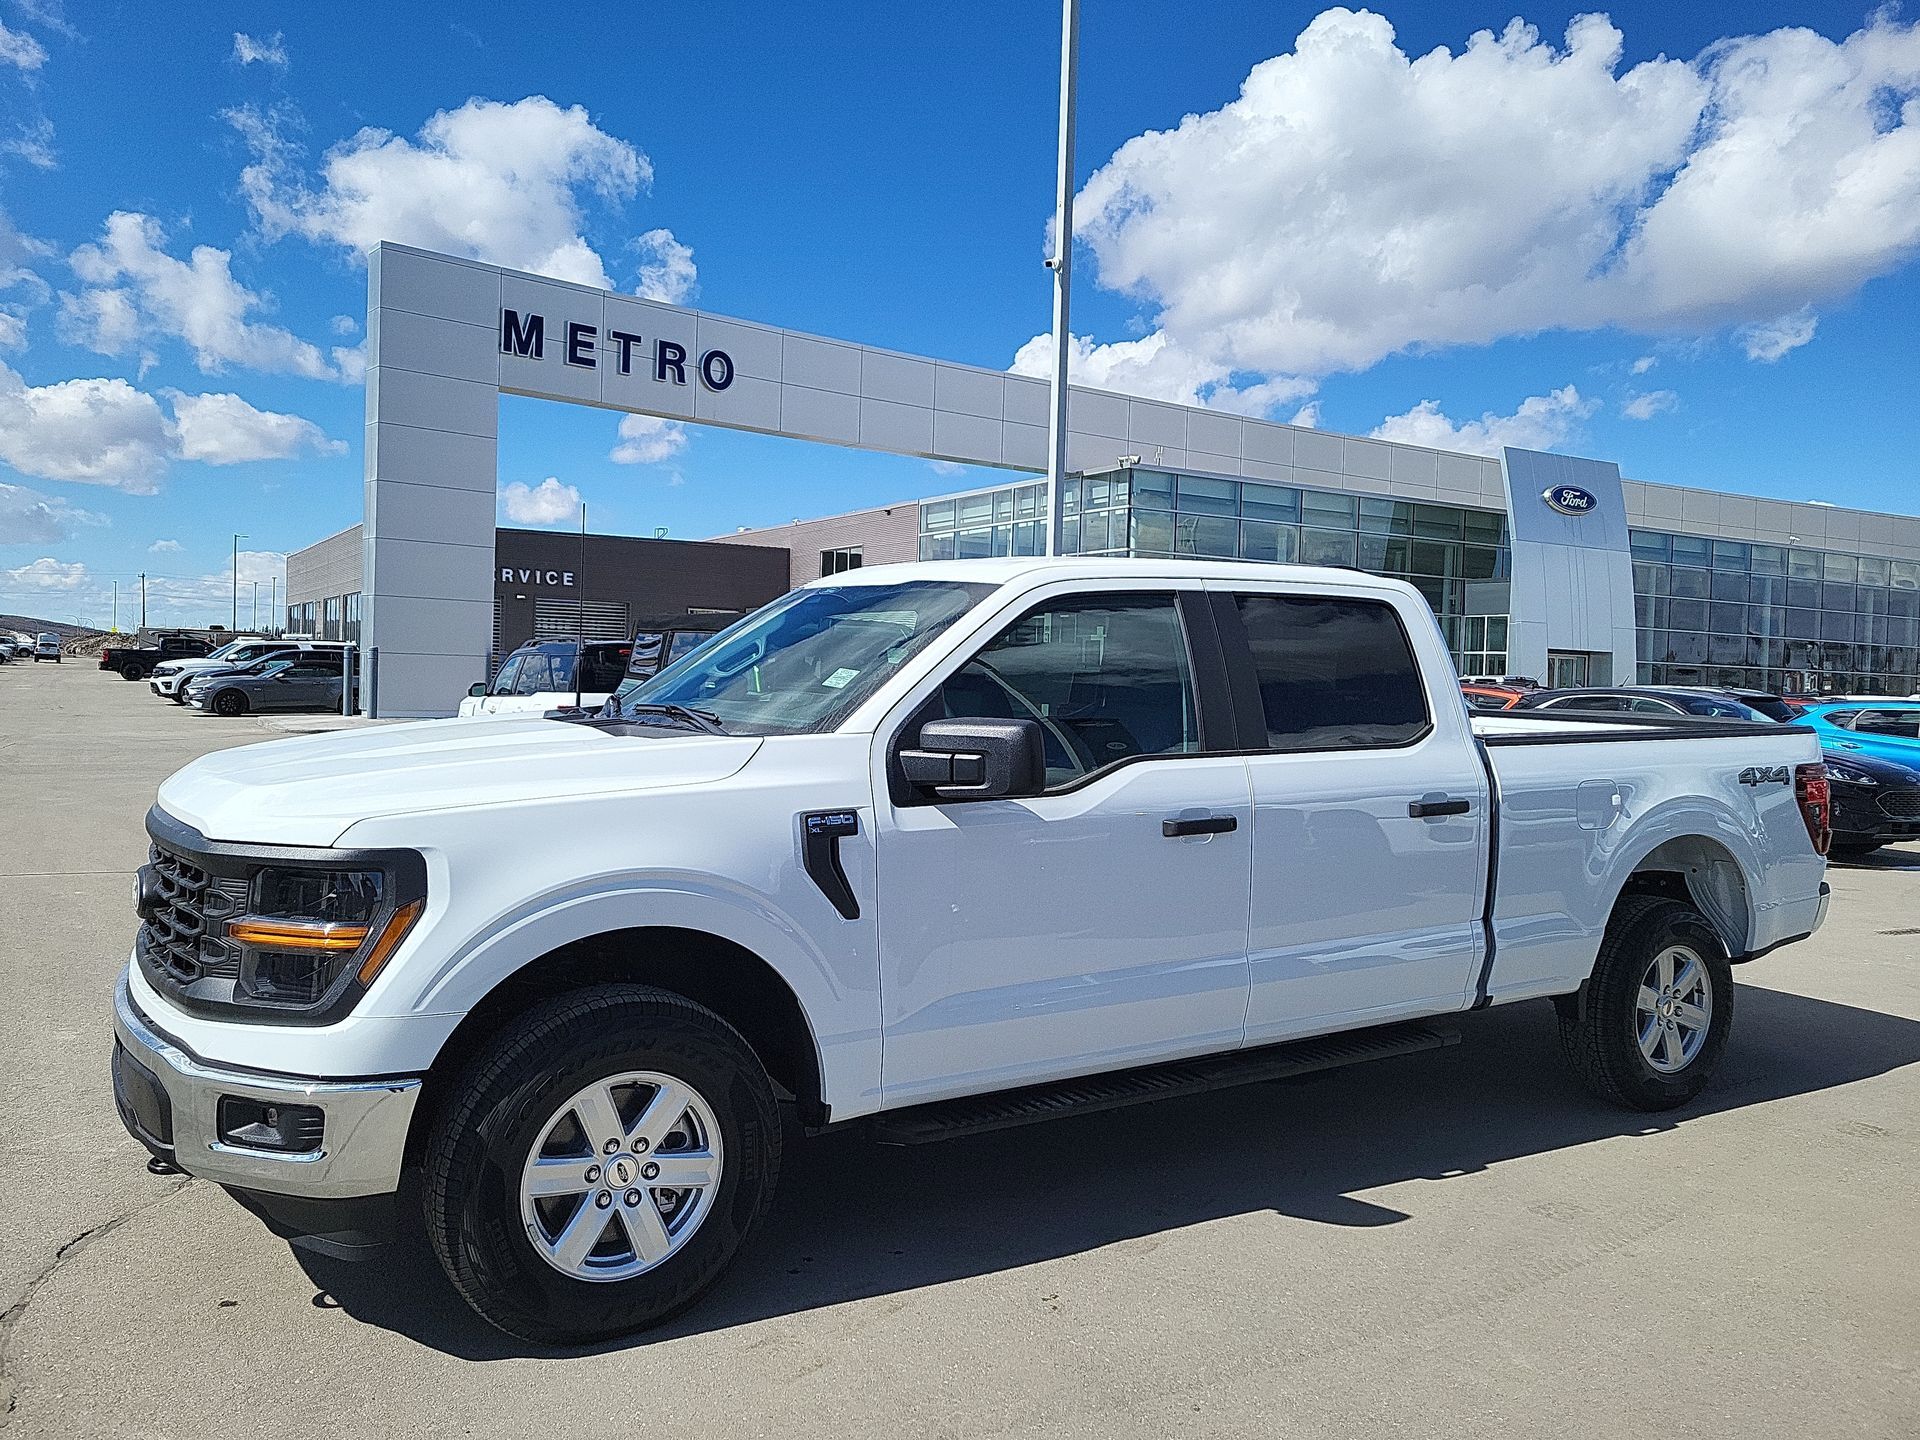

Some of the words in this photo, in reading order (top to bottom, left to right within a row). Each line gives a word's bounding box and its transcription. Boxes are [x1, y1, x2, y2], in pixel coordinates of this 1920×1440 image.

[500, 308, 736, 393] METRO
[1561, 489, 1588, 508] Ford
[494, 567, 574, 586] RVICE
[808, 814, 854, 827] F-150
